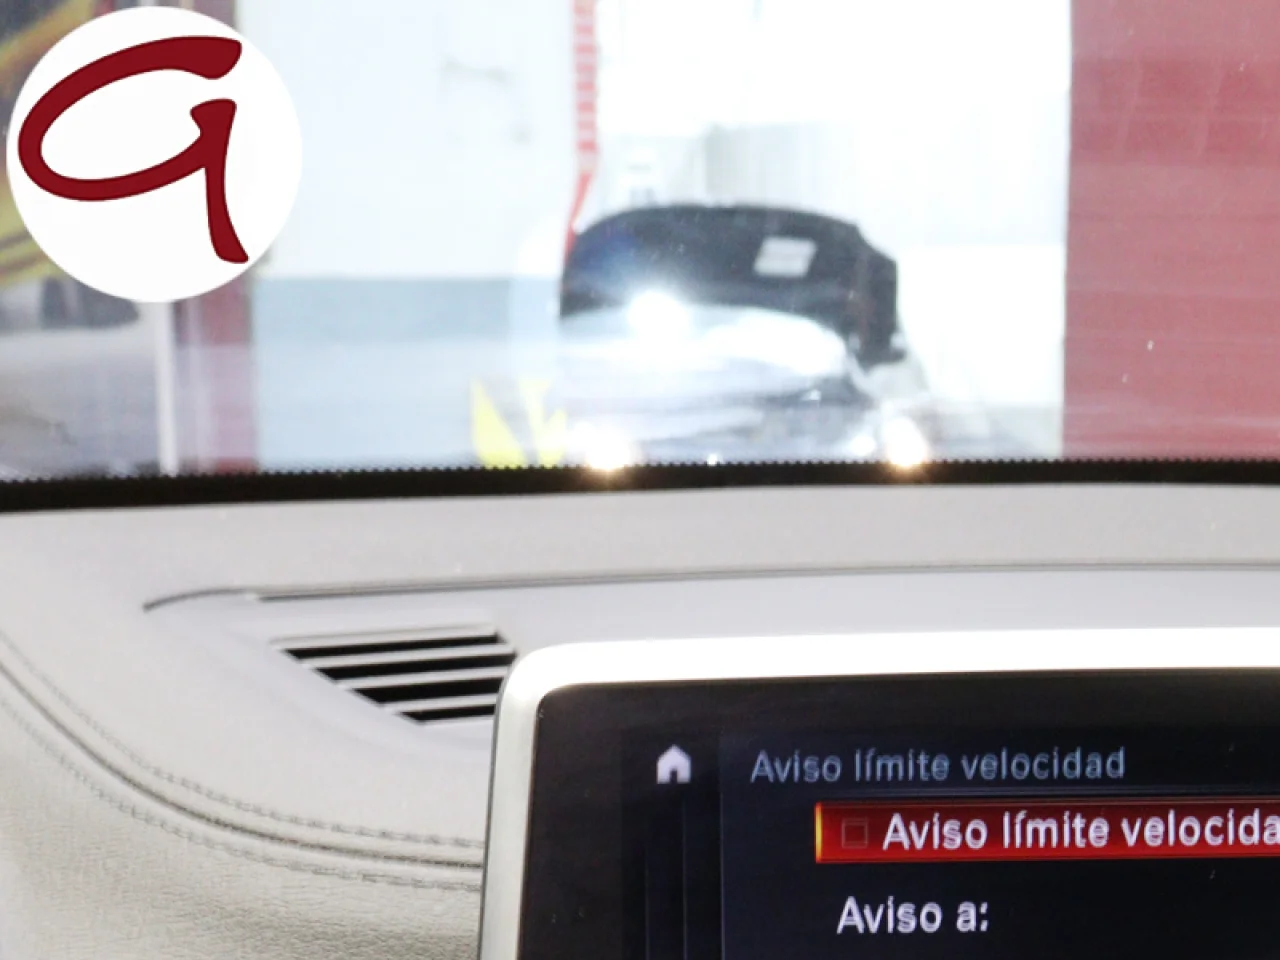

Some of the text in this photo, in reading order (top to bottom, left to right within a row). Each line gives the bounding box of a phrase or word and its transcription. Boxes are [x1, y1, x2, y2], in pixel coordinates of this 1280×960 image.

[750, 745, 1126, 783] Aviso límite velocidad
[881, 811, 989, 851] Aviso
[1002, 809, 1110, 850] límite
[836, 895, 989, 934] Aviso a:
